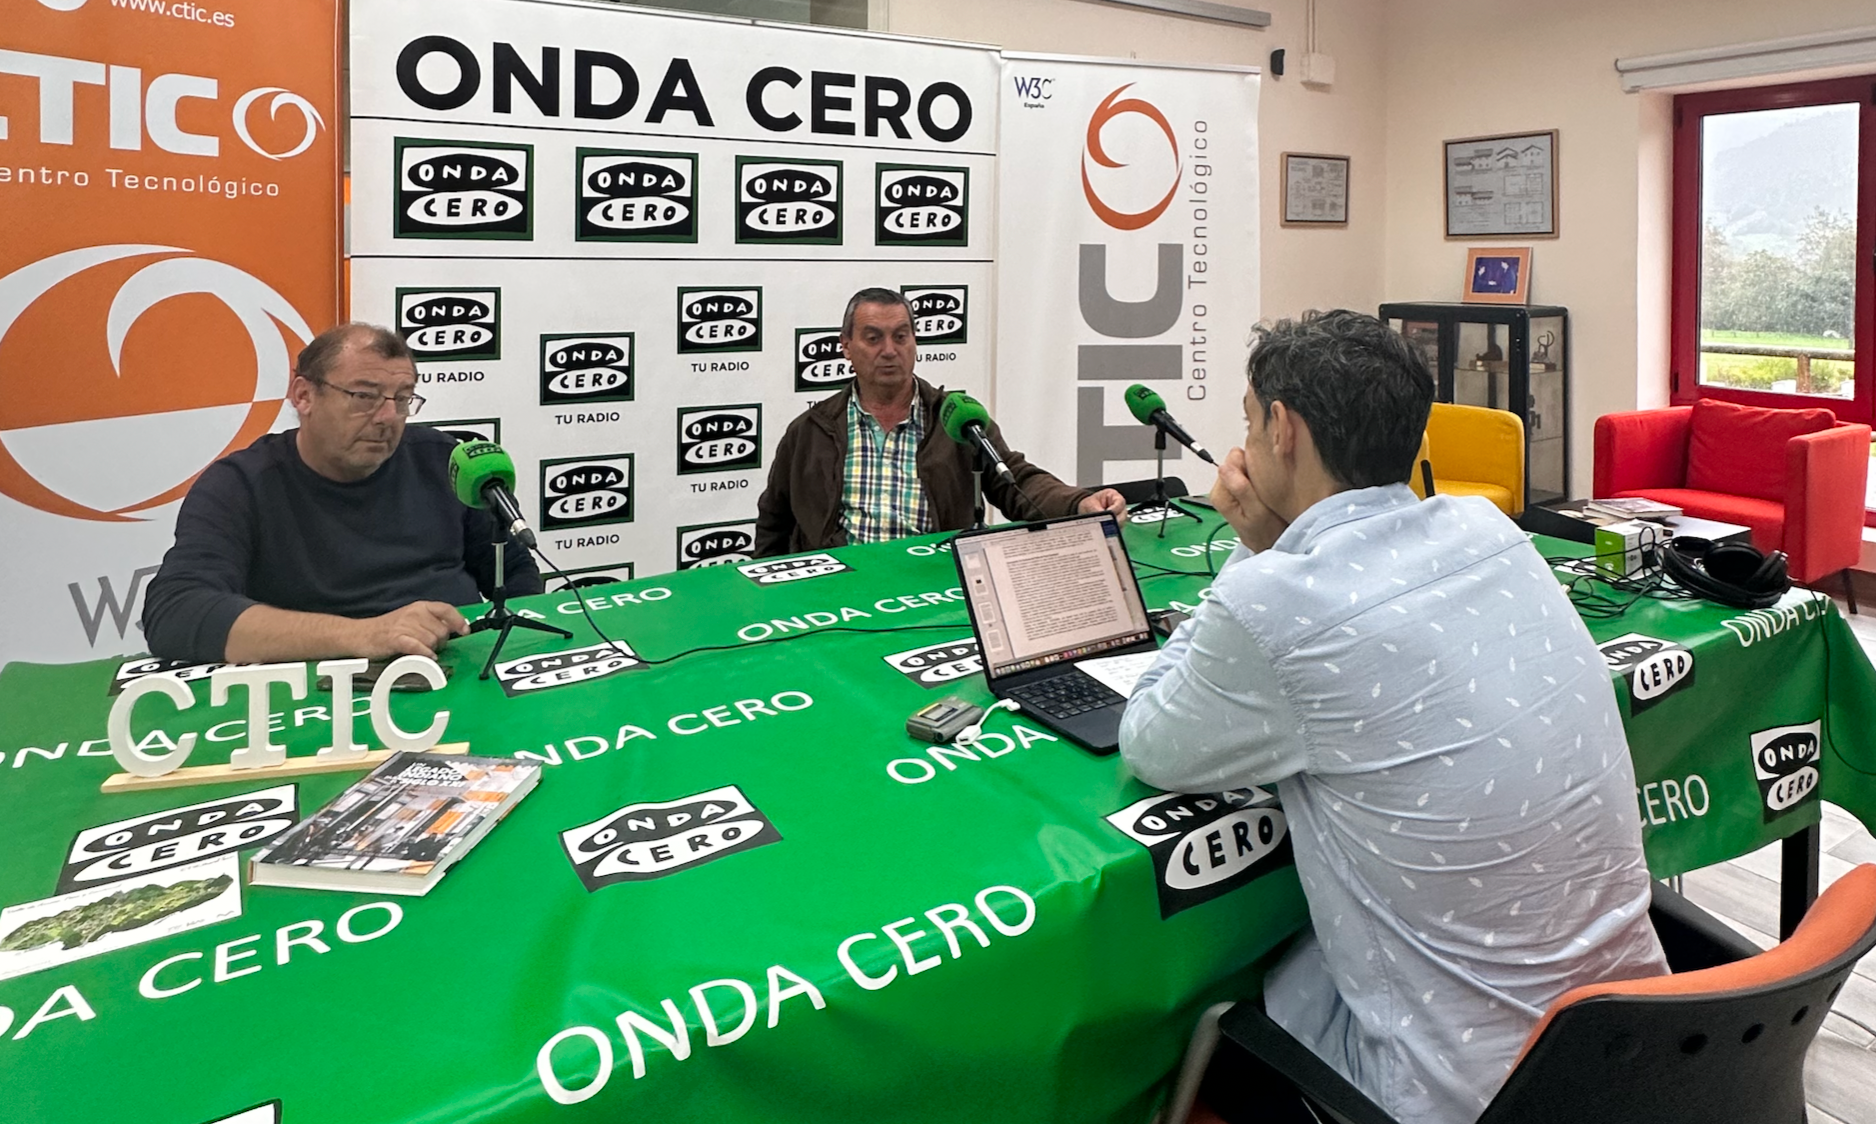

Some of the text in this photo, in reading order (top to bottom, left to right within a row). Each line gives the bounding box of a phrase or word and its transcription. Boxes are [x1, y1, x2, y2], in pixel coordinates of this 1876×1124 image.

[110, 0, 235, 28] www.ctic.es
[395, 34, 973, 143] ONDA CERO
[1014, 76, 1052, 99] W3C
[0, 49, 219, 157] TIC
[0, 166, 280, 199] entro Tecnológico
[418, 164, 508, 181] ONDA
[597, 171, 676, 188] ONDA
[754, 178, 824, 194] ONDA
[891, 184, 952, 199] ONDA
[423, 197, 509, 217] CERO
[602, 203, 676, 221] CERO
[758, 207, 824, 225] CERO
[895, 212, 951, 228] CERO
[1187, 119, 1212, 401] Centro Tecnológico
[414, 305, 482, 320] ONDA
[692, 302, 747, 315] ONDA
[912, 300, 956, 311] ONDA
[418, 330, 482, 346] CERO
[695, 324, 747, 339] CERO
[556, 349, 618, 364] ONDA
[691, 361, 750, 372] TU RADIO
[925, 352, 957, 362] RADIO
[1076, 243, 1184, 486] TIC
[437, 371, 485, 383] RADIO
[560, 373, 618, 389] CERO
[554, 411, 620, 425] TU RADIO
[691, 420, 747, 436] ONDA
[695, 442, 747, 459] CERO
[556, 471, 617, 489] ONDA
[690, 479, 749, 493] TU RADIO
[560, 496, 617, 514] CERO
[555, 534, 620, 550] TU RADIO
[691, 536, 746, 554] ONDA
[1171, 536, 1241, 557] OND
[771, 566, 834, 580] CERO
[556, 586, 673, 615] CERO
[737, 606, 872, 642] ONDA
[514, 648, 618, 674] ONDA
[906, 644, 979, 666] OND
[530, 660, 623, 684] CERO
[1640, 655, 1685, 691] CERO
[107, 654, 451, 778] CTIC
[514, 690, 814, 766] NDA CERO
[886, 724, 1059, 784] ONDA
[1764, 740, 1814, 767] ONDA
[1776, 773, 1813, 803] CERO
[1141, 791, 1245, 830] ONDA
[104, 802, 265, 847] ONDA
[593, 803, 726, 845] ONDA
[107, 825, 265, 870] CERO
[617, 827, 742, 865] CERO
[1183, 815, 1273, 876] CERO
[138, 901, 403, 999] CERO
[535, 884, 1036, 1106] ONDA CERO
